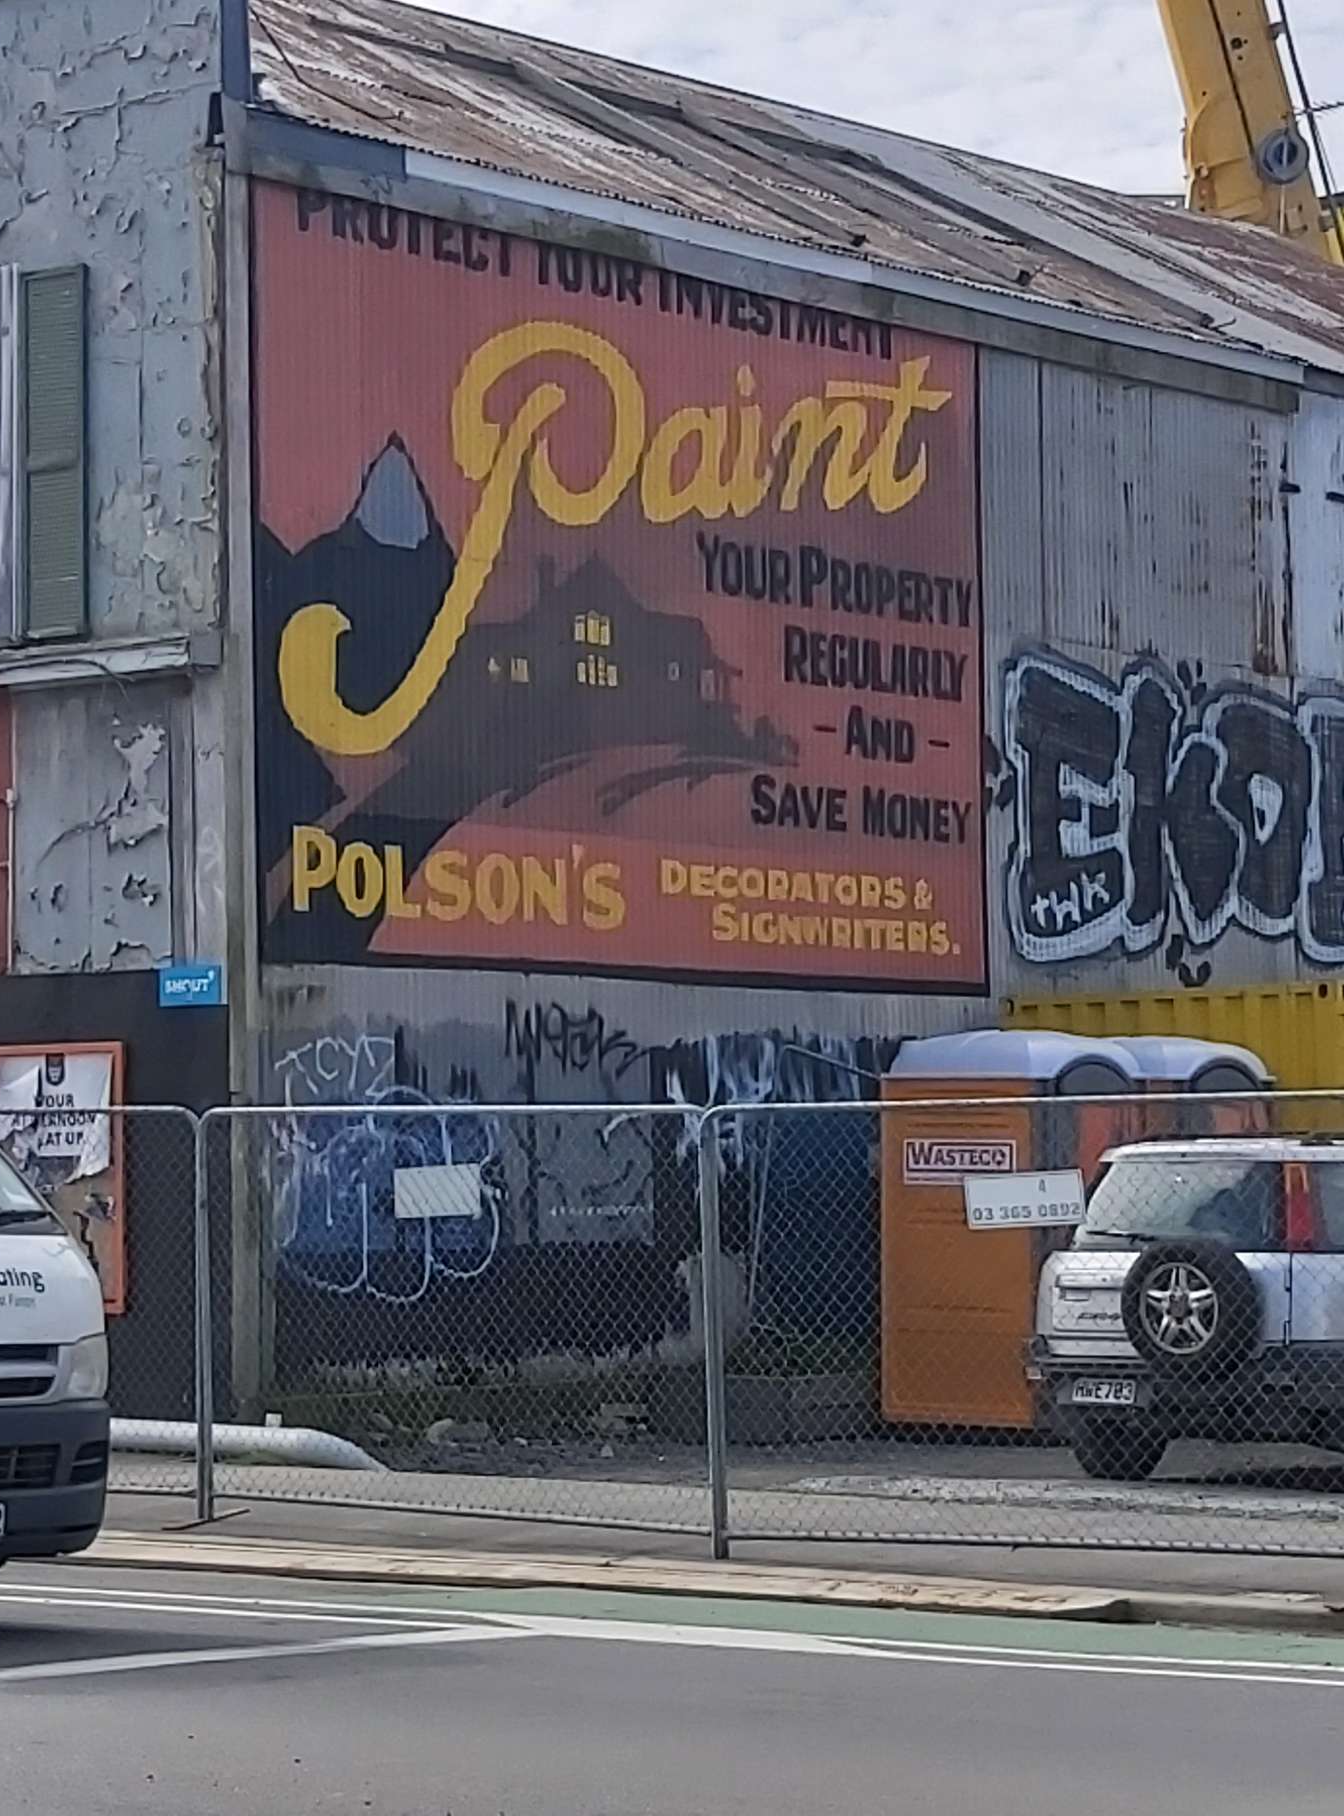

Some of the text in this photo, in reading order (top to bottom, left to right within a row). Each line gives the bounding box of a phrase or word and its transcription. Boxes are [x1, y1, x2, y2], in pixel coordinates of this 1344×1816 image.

[296, 190, 892, 360] PROTECT YOUR INVESTMENT
[279, 321, 952, 755] Paint
[697, 531, 973, 628] YOUR PROPERTY
[784, 624, 968, 702] REGULARLY
[845, 705, 915, 764] AND
[751, 775, 973, 844] SAVE MONEY
[292, 825, 628, 932] POLSON'S
[660, 858, 934, 911] DECORATORS &
[712, 902, 960, 956] SIGNWRITERS.
[972, 1207, 994, 1221] 03
